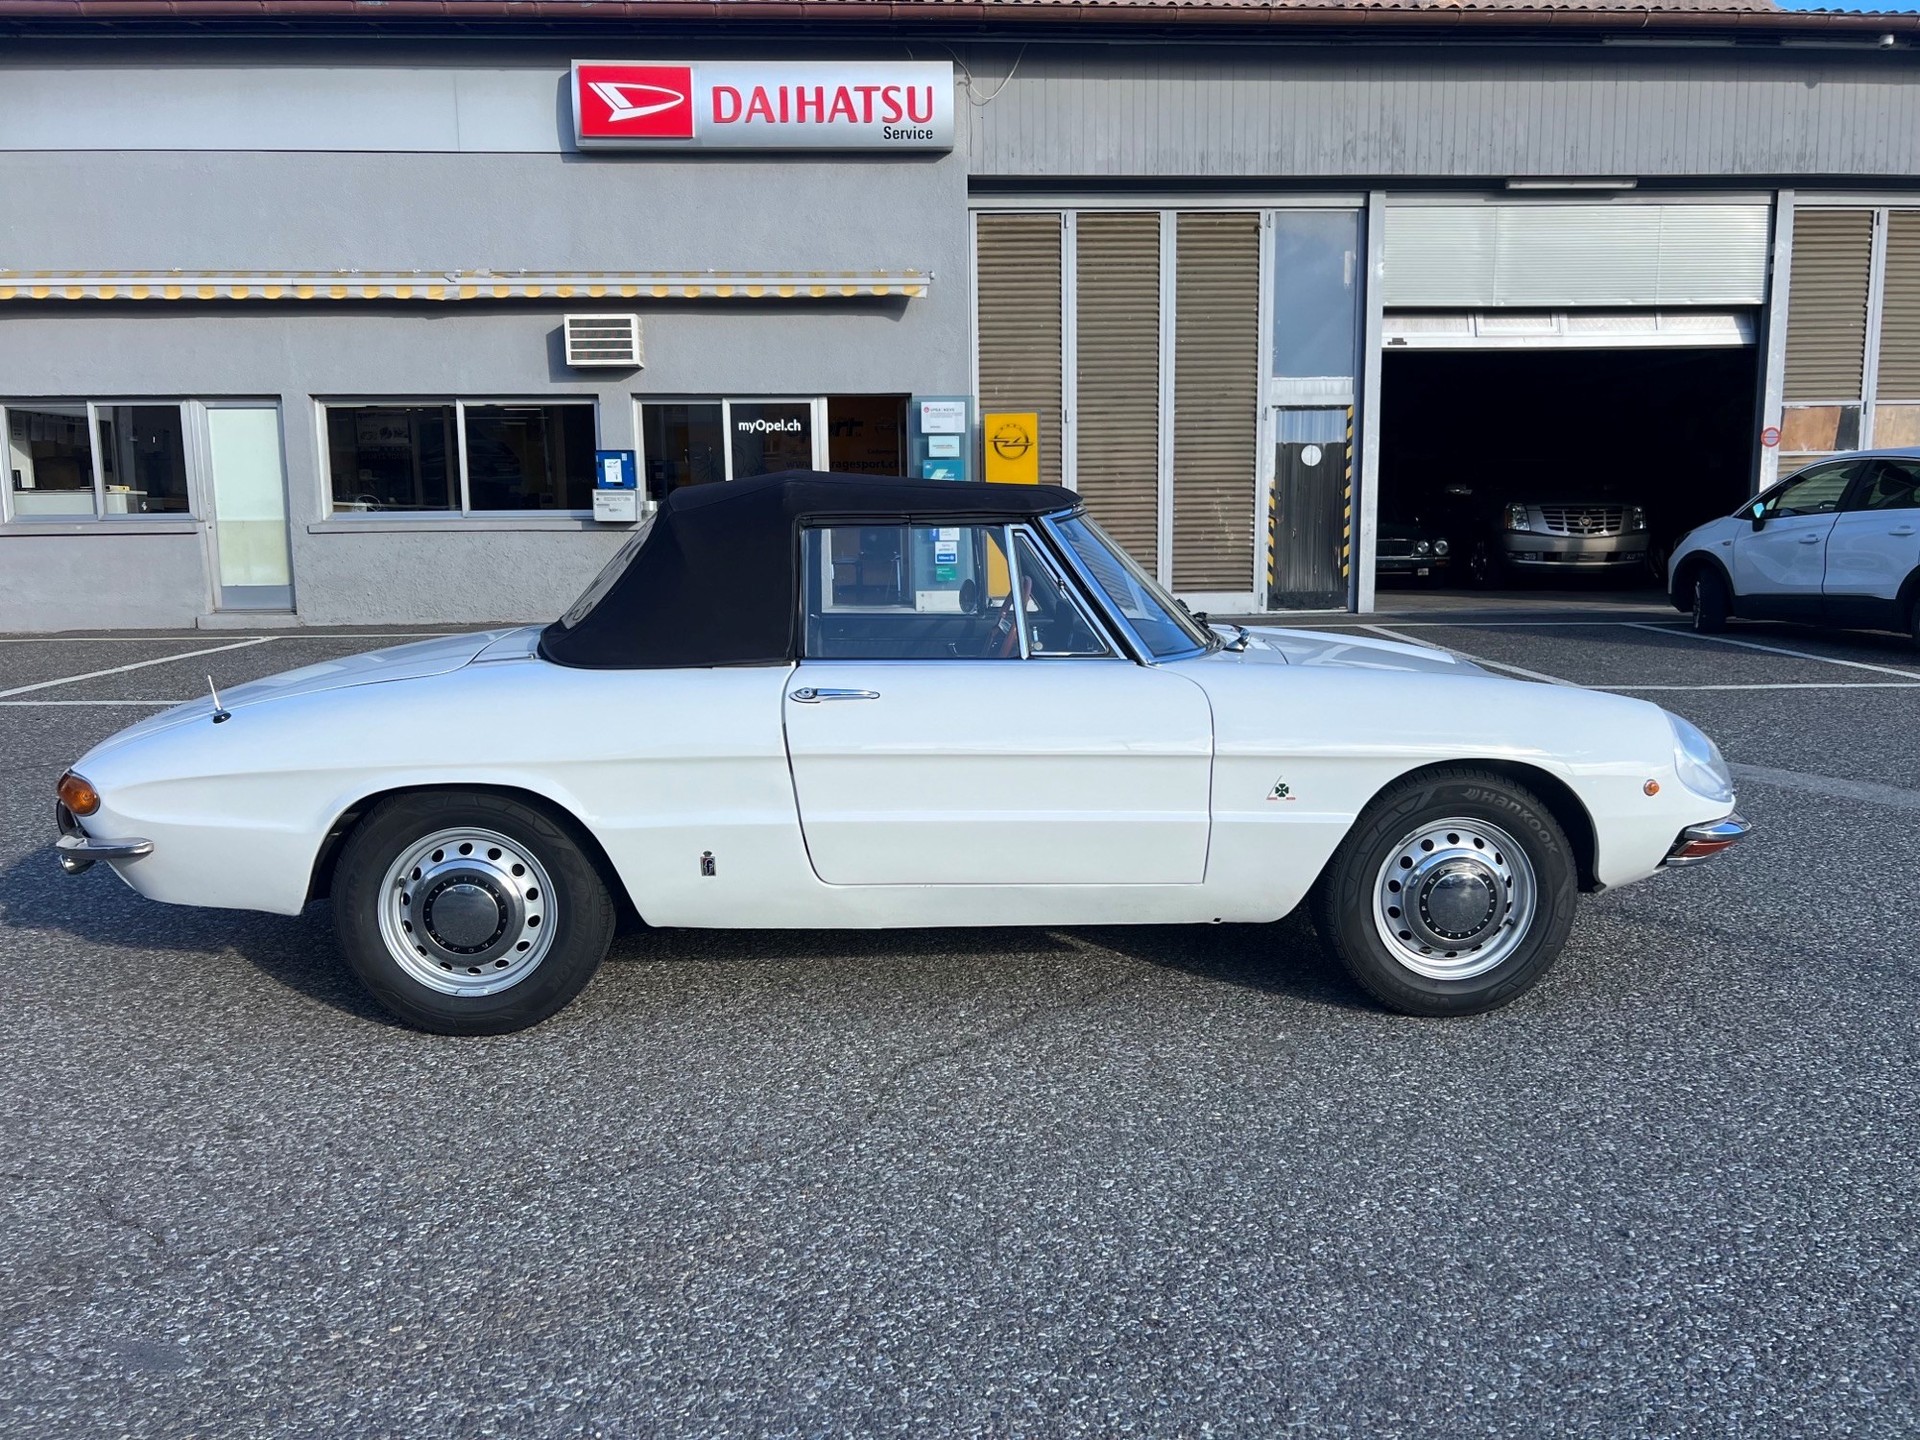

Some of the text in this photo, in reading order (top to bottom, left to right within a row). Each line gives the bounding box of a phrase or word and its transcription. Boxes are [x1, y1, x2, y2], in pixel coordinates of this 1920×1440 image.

[711, 85, 933, 124] DAIHATSU
[883, 126, 933, 141] Service
[738, 418, 801, 434] myOpel.ch
[1480, 790, 1560, 854] Hankook
